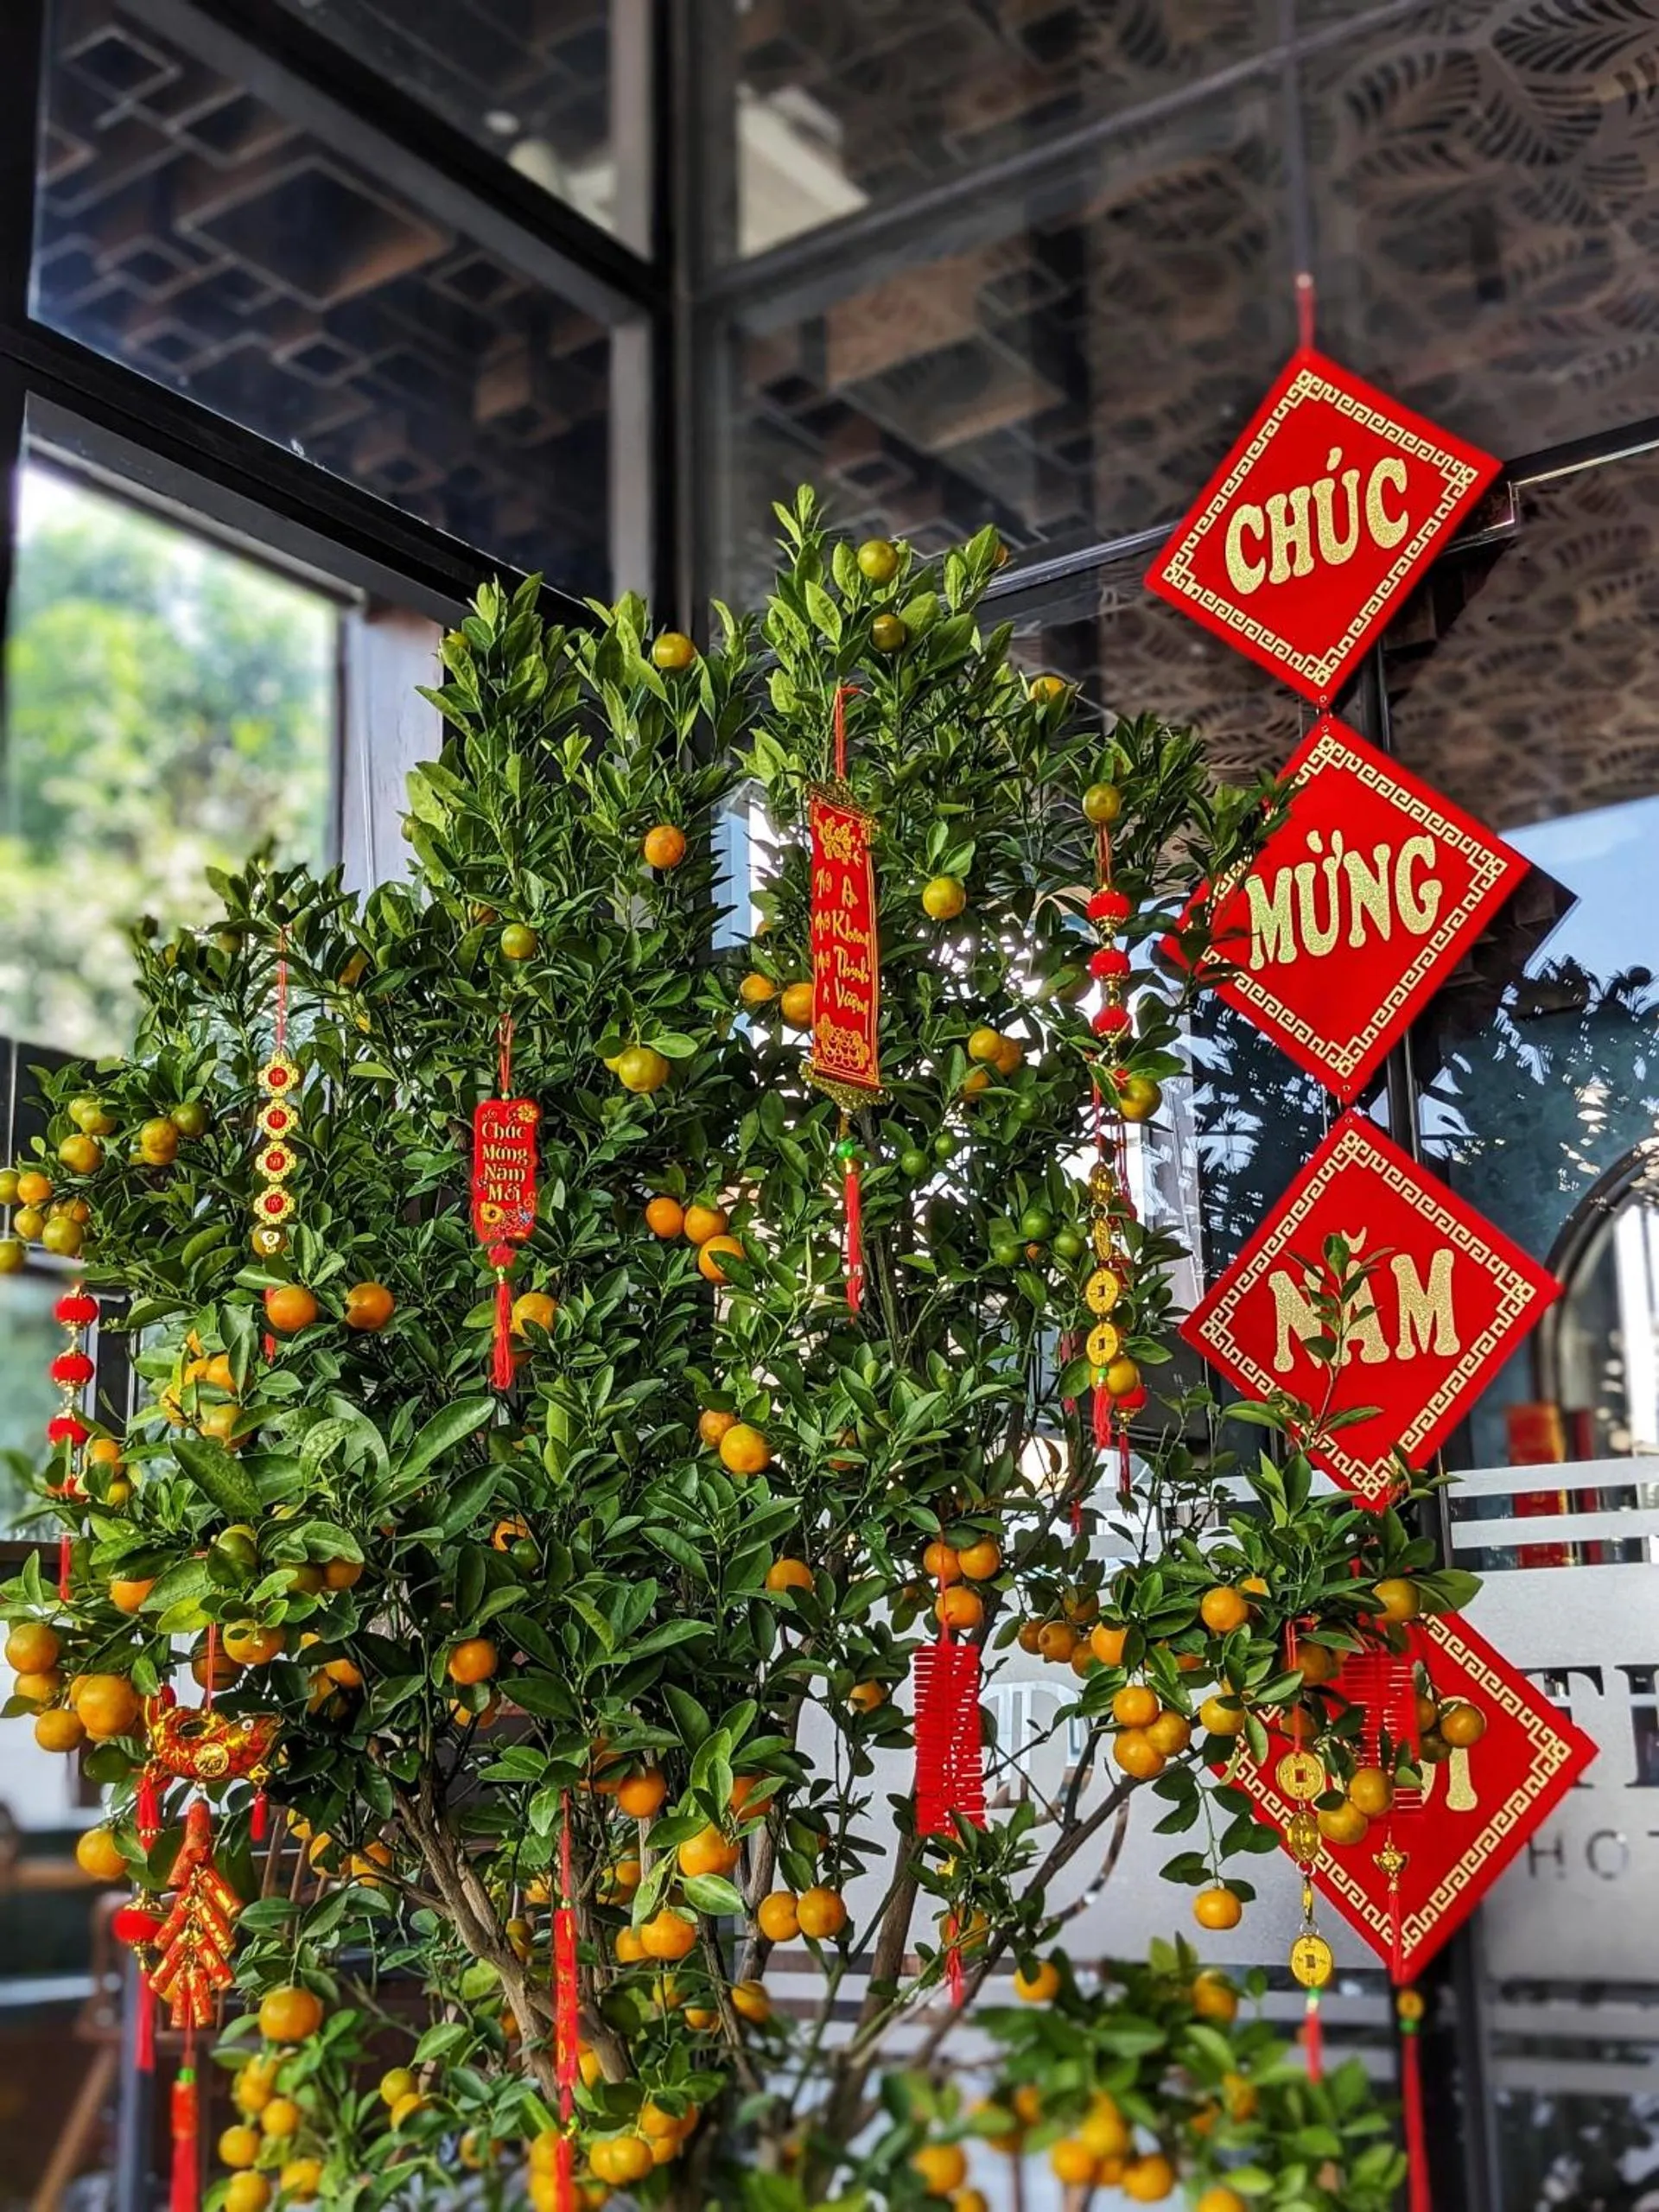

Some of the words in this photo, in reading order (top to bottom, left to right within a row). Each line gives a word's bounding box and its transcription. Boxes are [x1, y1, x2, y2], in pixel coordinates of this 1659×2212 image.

[1225, 447, 1408, 594] CHÚC
[1244, 830, 1443, 970] MỪNG
[481, 1121, 527, 1140] Chúc
[482, 1142, 528, 1165] Mừng
[484, 1163, 526, 1182] Năm
[487, 1184, 522, 1202] Mới
[1268, 1227, 1460, 1372] NĂM
